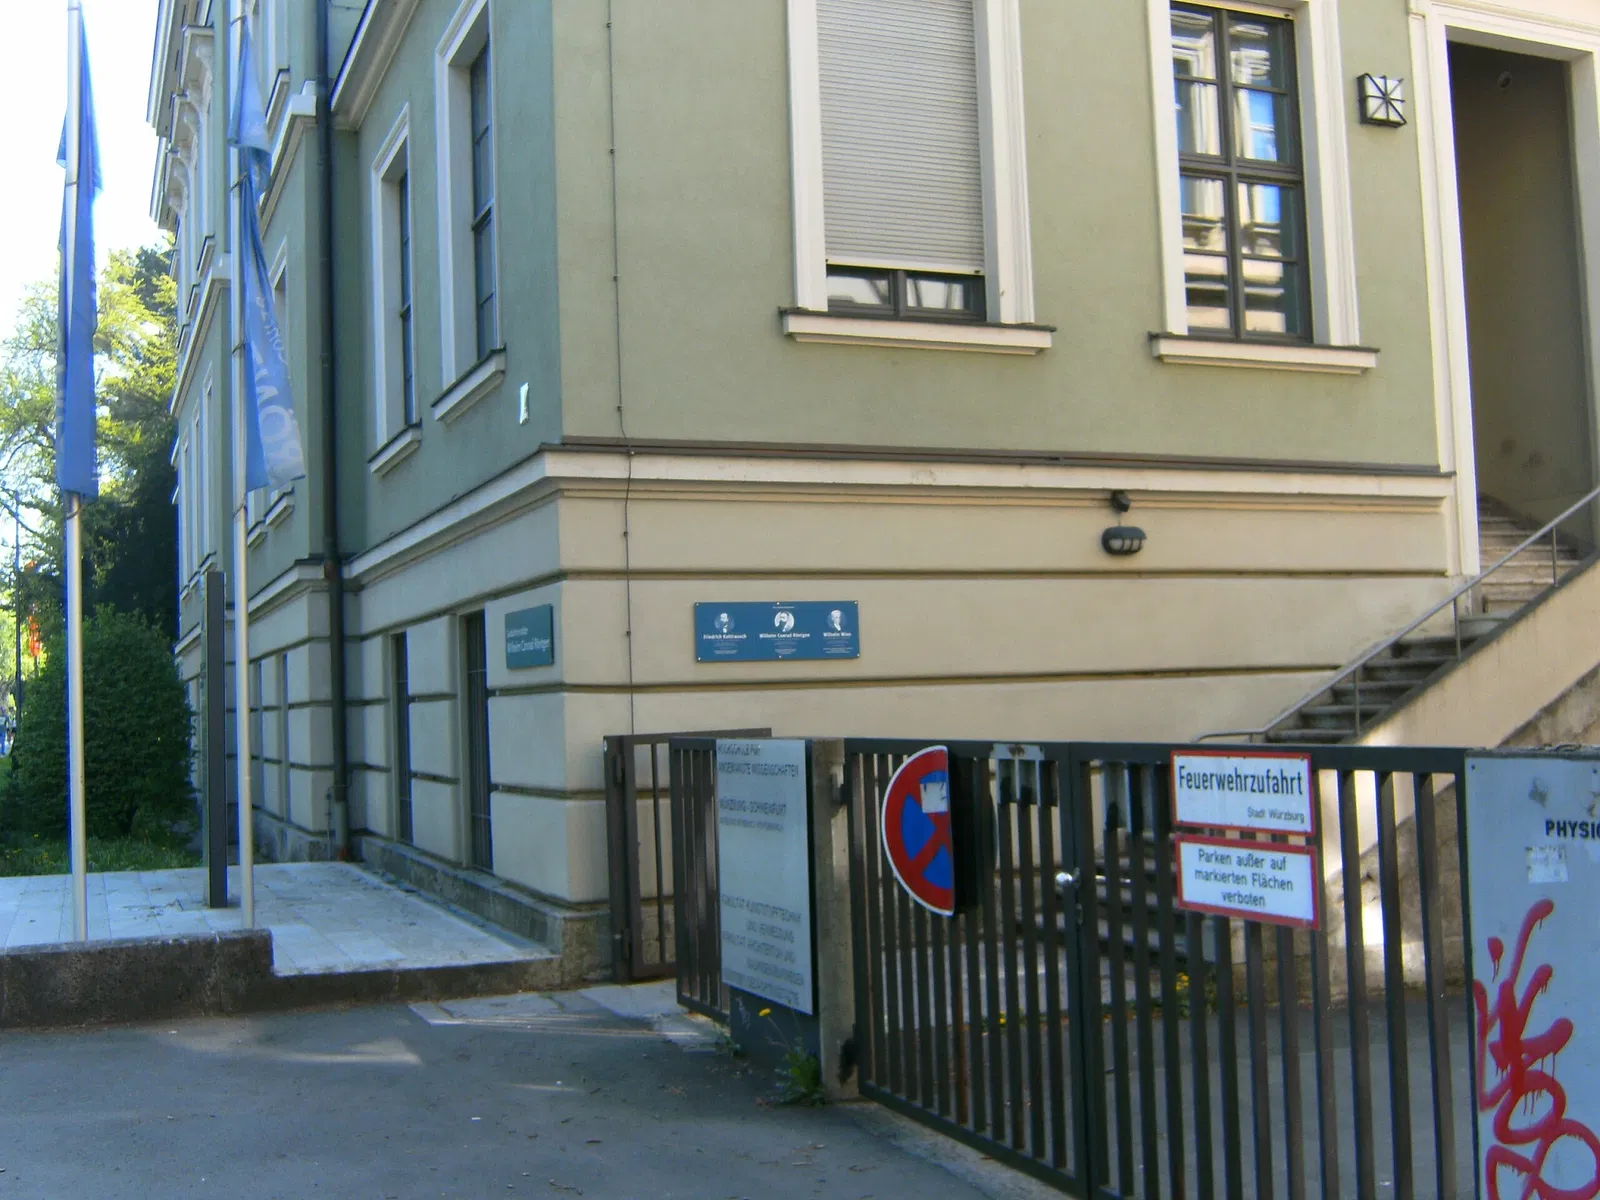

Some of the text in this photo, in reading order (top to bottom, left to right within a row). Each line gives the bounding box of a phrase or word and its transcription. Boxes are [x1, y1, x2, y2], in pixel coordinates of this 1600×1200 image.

[1178, 765, 1303, 795] Feuerwehrzufahrt
[1247, 806, 1305, 823] Stadt Würzburg
[1198, 849, 1287, 871] Parken außer auf
[1194, 869, 1294, 891] markierten Flächen
[1221, 890, 1266, 906] verboten
